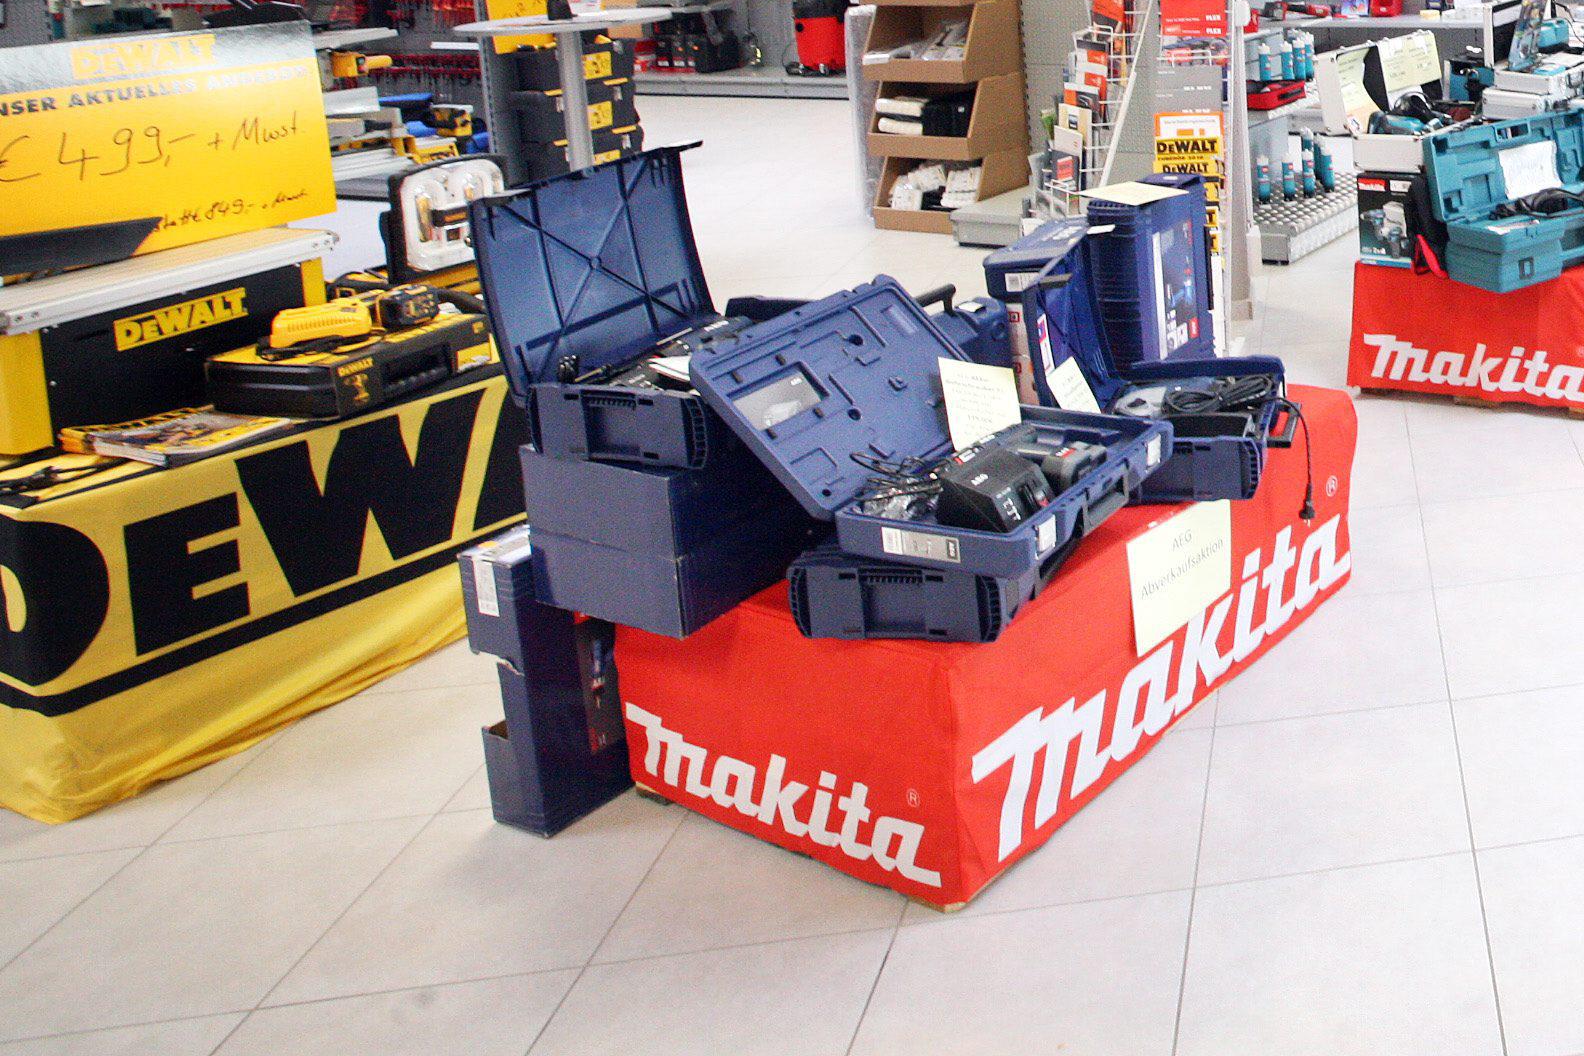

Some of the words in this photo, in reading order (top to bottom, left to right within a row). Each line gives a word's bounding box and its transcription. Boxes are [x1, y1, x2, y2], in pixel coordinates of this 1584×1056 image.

[68, 78, 197, 108] AKTUELLES
[1157, 139, 1217, 154] DEWALT
[119, 290, 248, 344] DEWALT
[1171, 529, 1193, 552] AEG
[1140, 537, 1225, 600] Abverkaufsaktion
